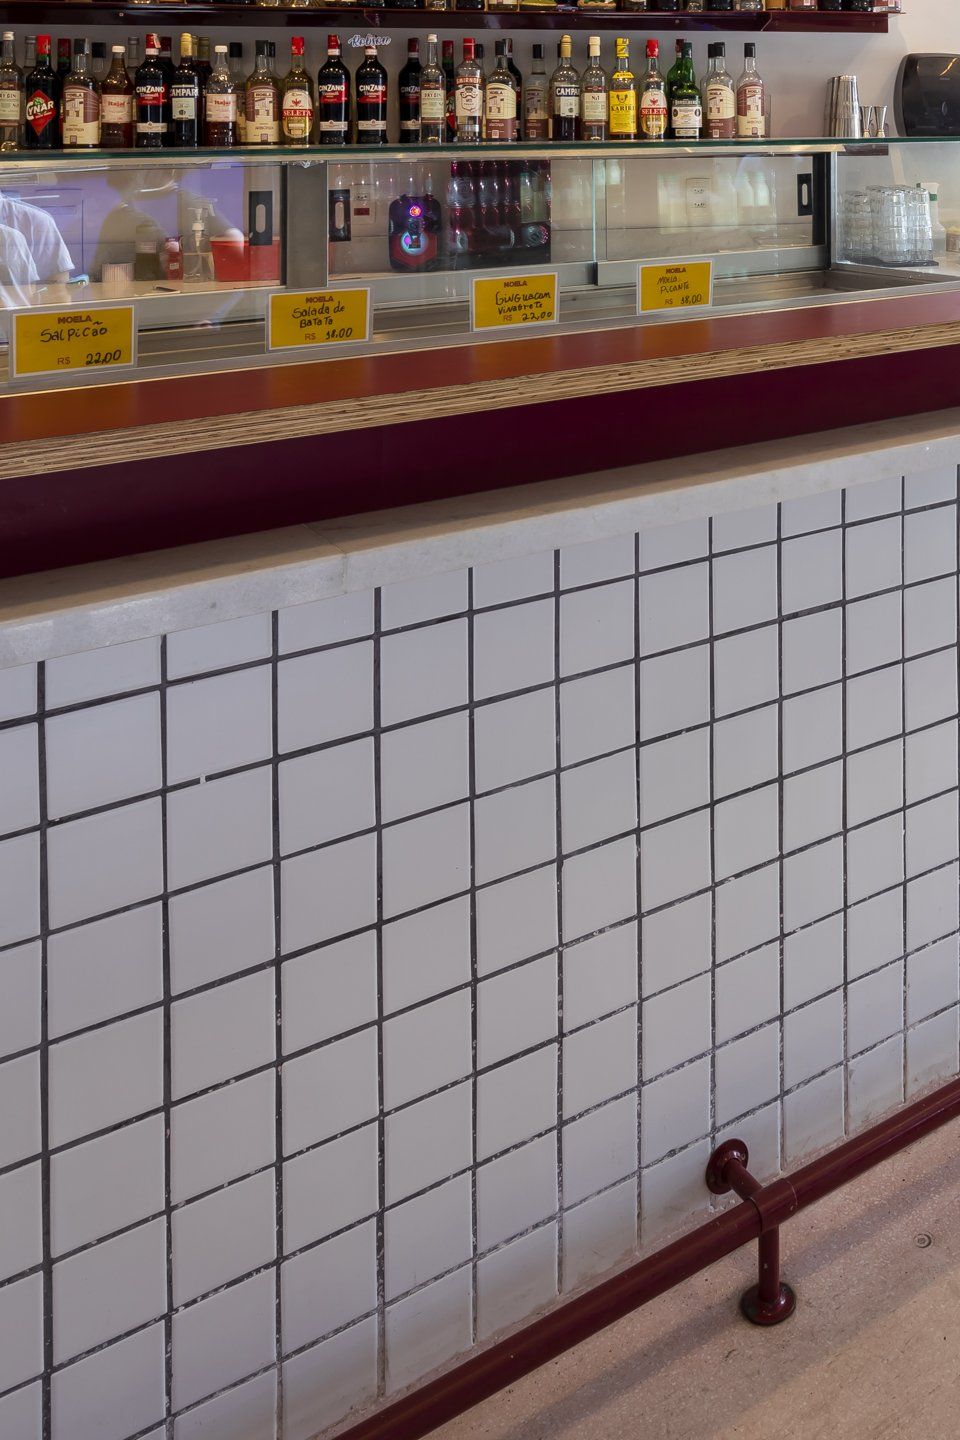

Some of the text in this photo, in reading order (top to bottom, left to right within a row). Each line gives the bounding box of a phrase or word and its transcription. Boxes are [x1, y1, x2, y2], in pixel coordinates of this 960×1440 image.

[136, 85, 165, 94] CINZANO
[319, 83, 345, 92] CINZANO
[359, 84, 386, 92] CINZANO
[27, 100, 54, 121] CYNAR
[57, 314, 94, 325] MOELA
